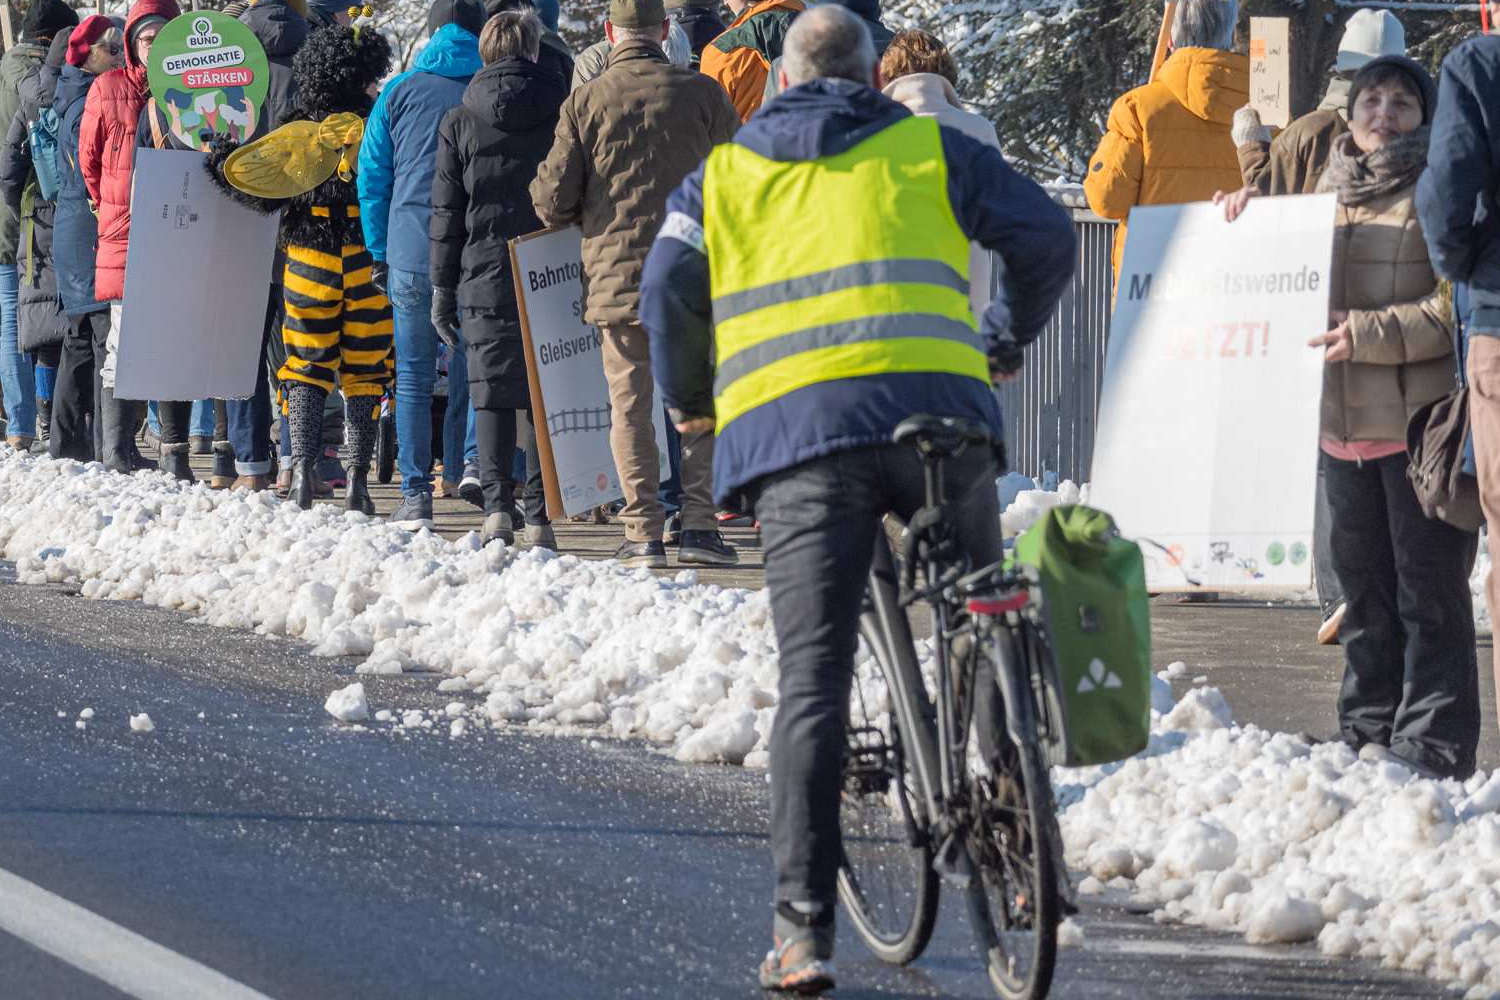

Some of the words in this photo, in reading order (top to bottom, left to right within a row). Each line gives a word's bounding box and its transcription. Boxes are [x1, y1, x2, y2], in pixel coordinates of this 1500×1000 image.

[190, 36, 219, 46] BUND
[166, 50, 241, 71] DEMOKRATIE
[187, 71, 248, 86] STÄRKEN
[1128, 264, 1320, 301] Mobiliätswende
[540, 327, 601, 366] Gleisverk
[1164, 320, 1271, 361] JETZT!
